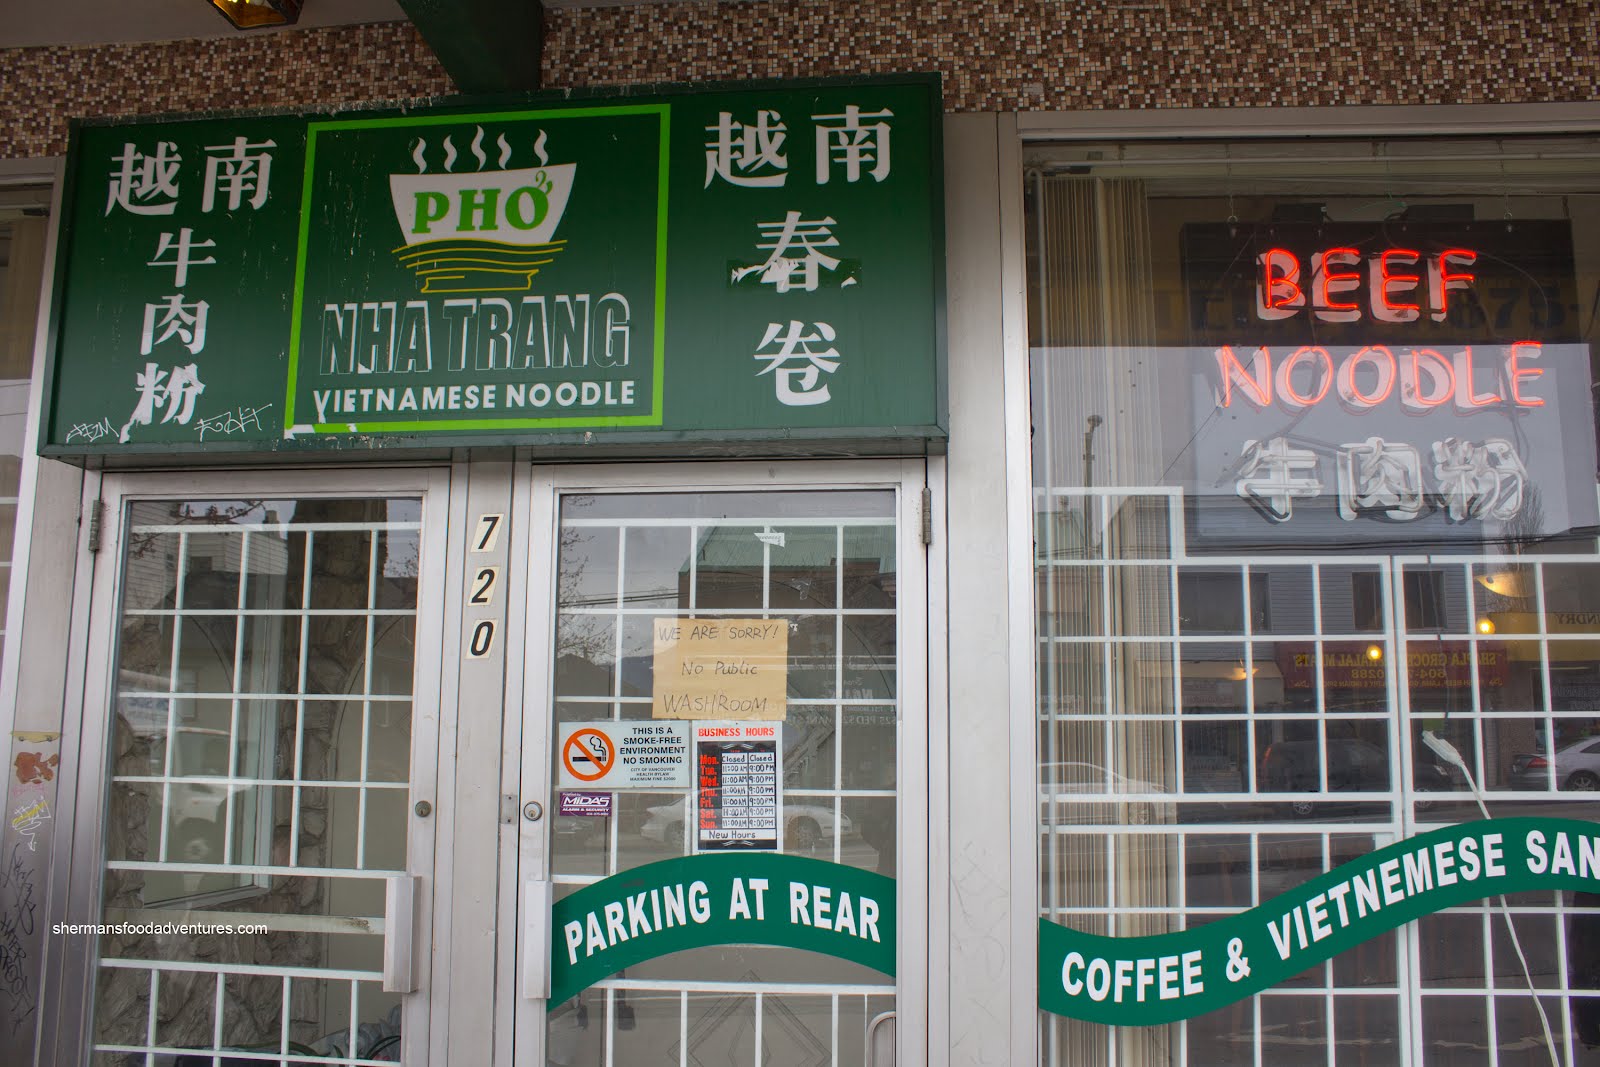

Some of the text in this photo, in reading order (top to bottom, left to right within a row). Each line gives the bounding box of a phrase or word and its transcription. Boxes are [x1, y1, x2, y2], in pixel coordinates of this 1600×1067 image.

[704, 104, 895, 190] 越南
[105, 136, 278, 217] 越南
[1256, 248, 1478, 322] BEEF
[134, 228, 217, 426] 牛肉粉
[320, 293, 631, 375] NHA TRANG
[1215, 341, 1545, 409] NOODLE
[313, 380, 635, 415] VIETNAMESE NOODLE
[658, 624, 779, 641] WE ARE SORRY!
[681, 660, 758, 676] No Public
[663, 693, 768, 714] WASHROOM
[632, 727, 653, 735] THIS
[698, 727, 775, 737] BUSINESS HOURS
[623, 736, 682, 745] SMOKE-FREE
[619, 746, 686, 755] ENVIRONMENT
[623, 756, 683, 765] NO SMOKING
[700, 754, 773, 765] Mon. Closed Closed
[700, 765, 717, 775] Tue.
[700, 776, 719, 787] Wed.
[563, 796, 610, 806] MIDAS
[700, 797, 714, 808] Fri.
[700, 808, 717, 819] Sat.
[700, 819, 718, 829] Sun.
[709, 831, 756, 839] New Hours
[564, 878, 880, 965] PARKING AT REAR
[1062, 951, 1204, 1003] COFFEE
[1225, 937, 1251, 982] &
[1266, 833, 1506, 961] VIETNEMESE
